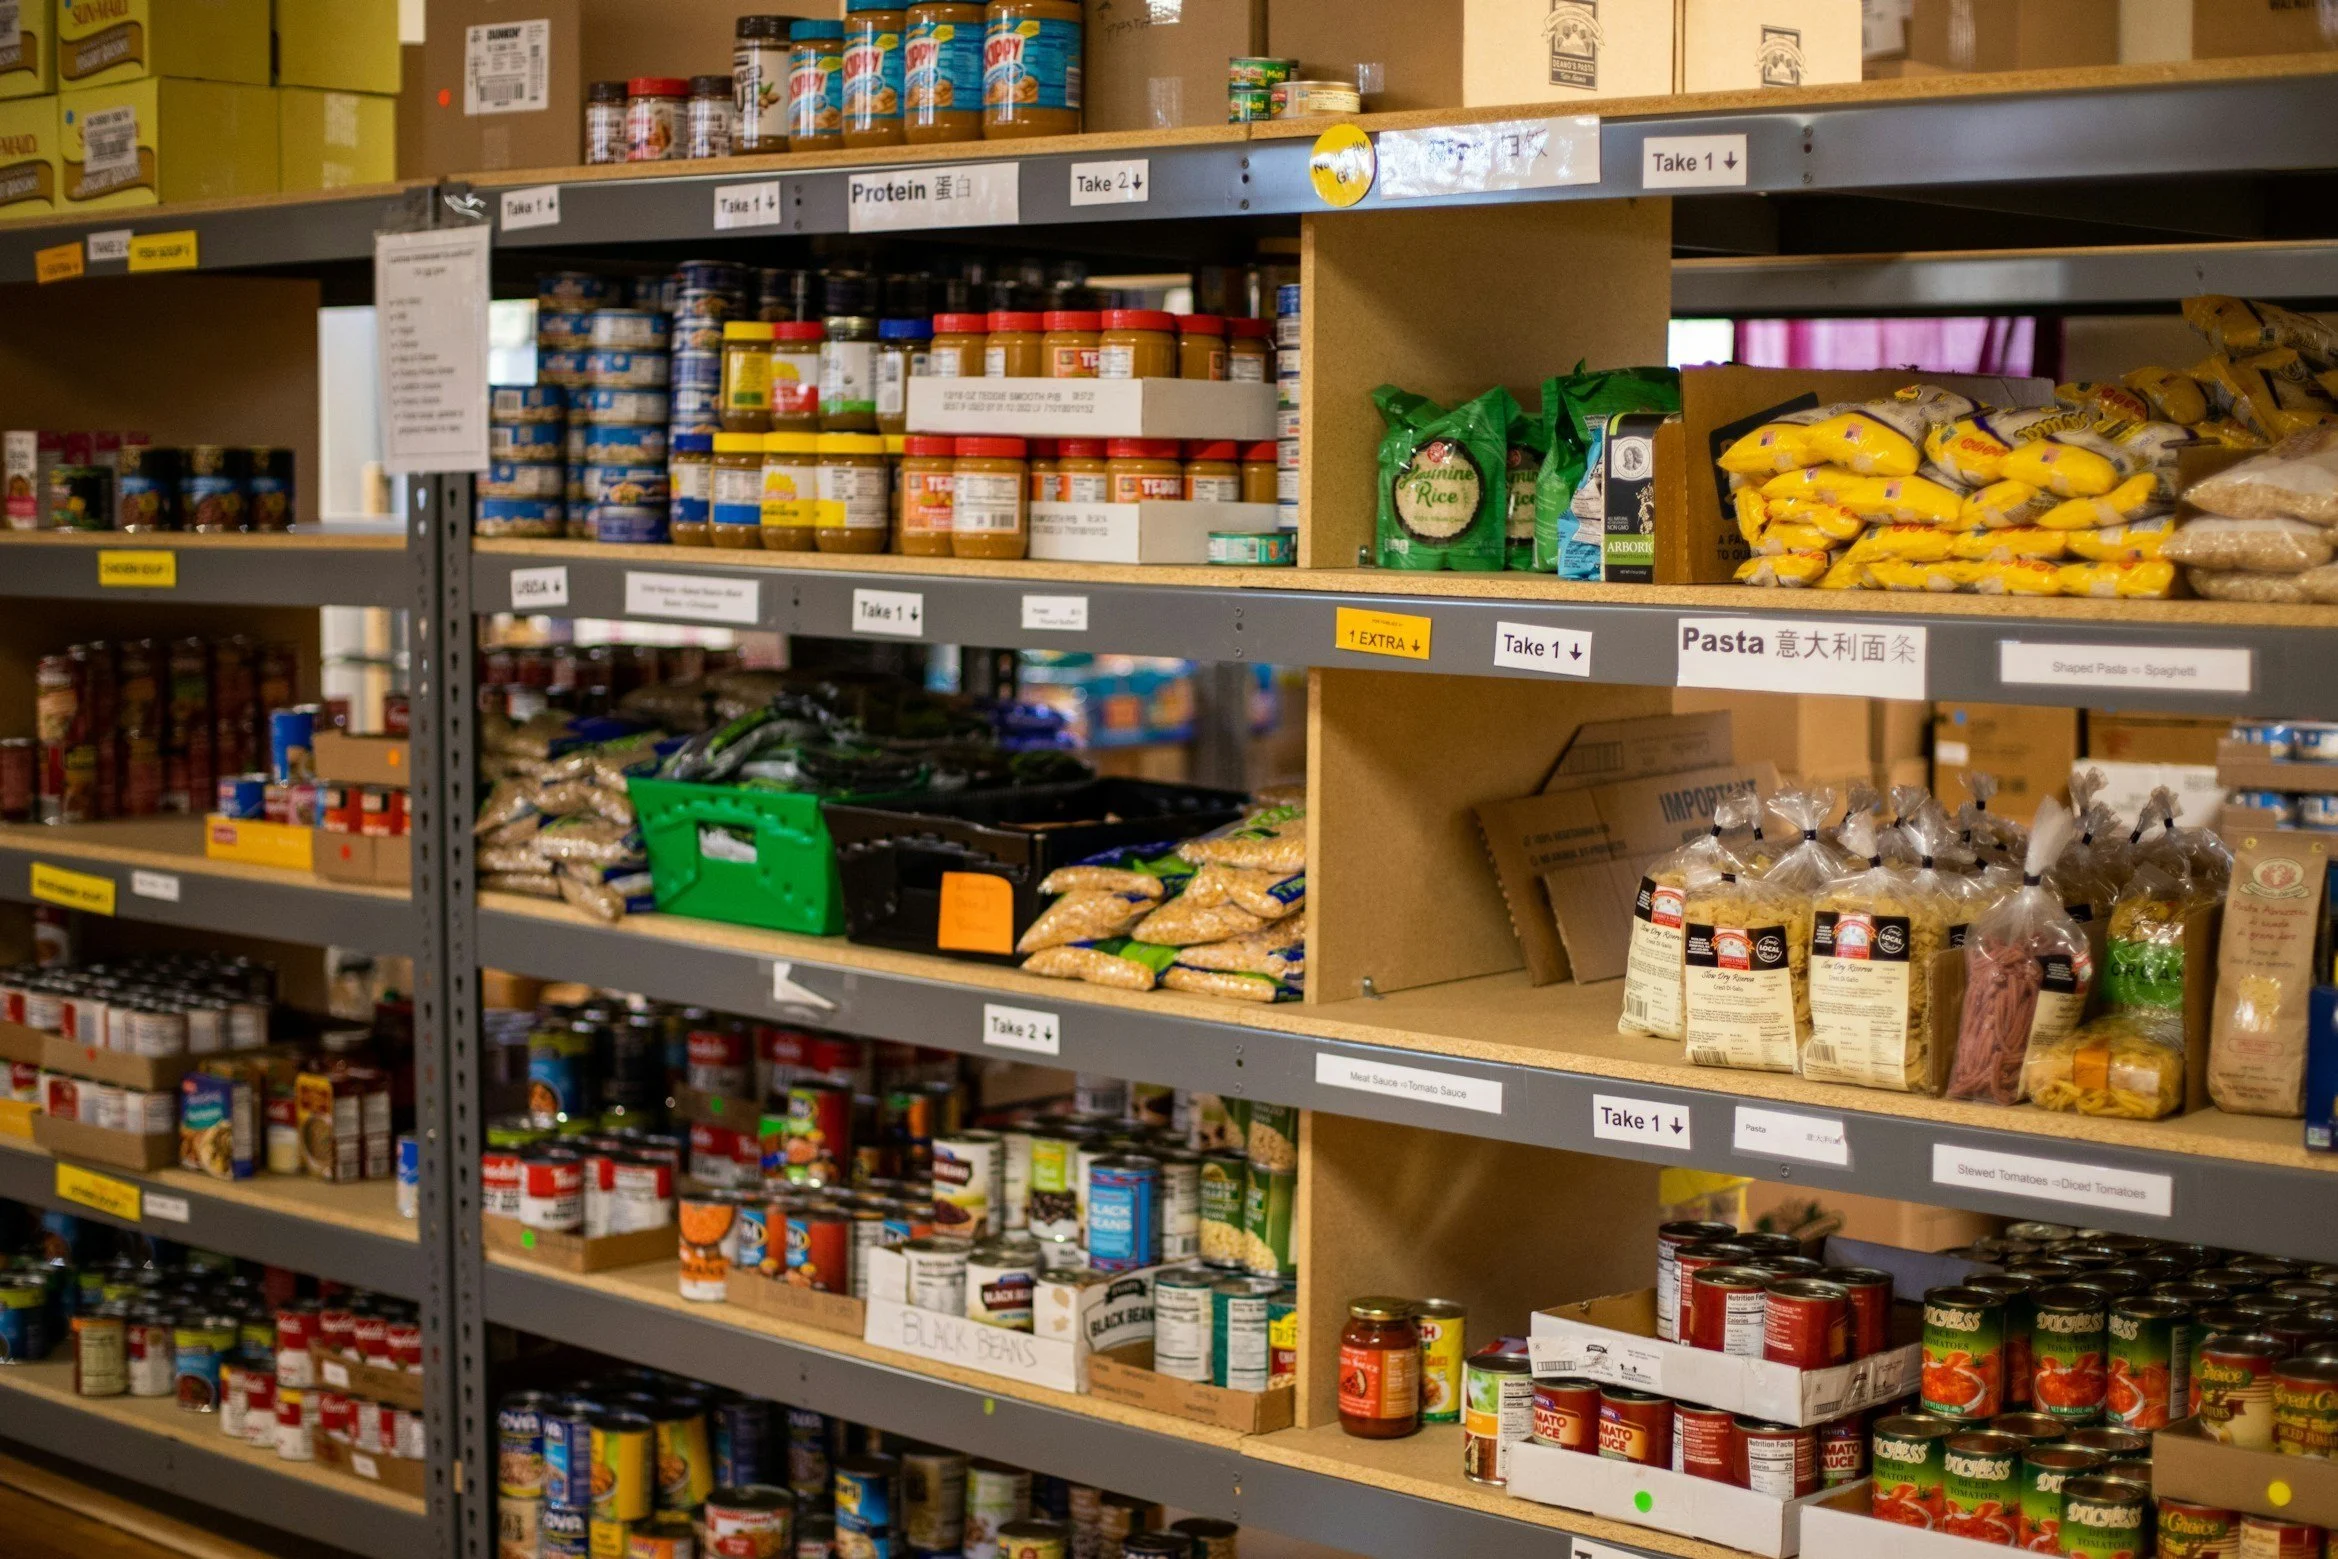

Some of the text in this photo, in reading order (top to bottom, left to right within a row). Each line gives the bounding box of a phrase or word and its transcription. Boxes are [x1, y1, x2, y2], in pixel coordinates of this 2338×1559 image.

[1653, 151, 1713, 173] Take 1
[935, 174, 972, 201] 蛋白
[1077, 172, 1129, 193] Take 2
[851, 181, 927, 204] Protein
[506, 202, 533, 217] Take
[721, 197, 760, 214] Take 1
[1398, 463, 1476, 490] Jasmine
[1416, 480, 1459, 509] Rice
[860, 601, 903, 622] Take 1
[1349, 629, 1405, 652] 1 EXTRA
[1503, 633, 1559, 659] Take 1
[1682, 626, 1765, 655] Pasta
[1775, 628, 1916, 665] 意大利面条
[2052, 661, 2197, 678] Shaped Pasta Spaghetti
[1759, 945, 1780, 953] LOCAL
[1881, 934, 1903, 946] LOCAL
[1702, 969, 1717, 979] Slow
[1717, 972, 1730, 985] Dry
[992, 1016, 1037, 1039] Take 2
[1350, 1071, 1467, 1100] Meat Sauce Tomato Sauce
[1600, 1106, 1660, 1132] Take 1
[1745, 1123, 1767, 1134] Pasta
[1957, 1163, 2146, 1200] Stewed Tomatoes Diced Tomatoes
[1727, 1293, 1766, 1302] Nutrition Fac
[1089, 1305, 1154, 1338] BLACK BEAN
[1728, 1317, 1749, 1325] Calories
[2036, 1311, 2104, 1334] DUCHESS
[900, 1312, 1038, 1369] BLACK BEANS
[1931, 1327, 1958, 1340] DICED
[1503, 1380, 1527, 1388] Nutrition
[1534, 1411, 1568, 1429] MATO
[1534, 1425, 1561, 1440] AUCE
[1599, 1423, 1634, 1442] MATO
[1599, 1437, 1627, 1452] AUCE
[1749, 1439, 1794, 1449] Nutrition Facts
[1750, 1461, 1794, 1471] Calories 25
[1957, 1478, 1989, 1490] DICED
[1950, 1487, 2001, 1501] TOMATOES
[2067, 1501, 2142, 1529] DUCHESS
[2167, 1511, 2218, 1536] Choice
[2087, 1528, 2123, 1539] DICED
[2076, 1538, 2133, 1549] TOMATOES
